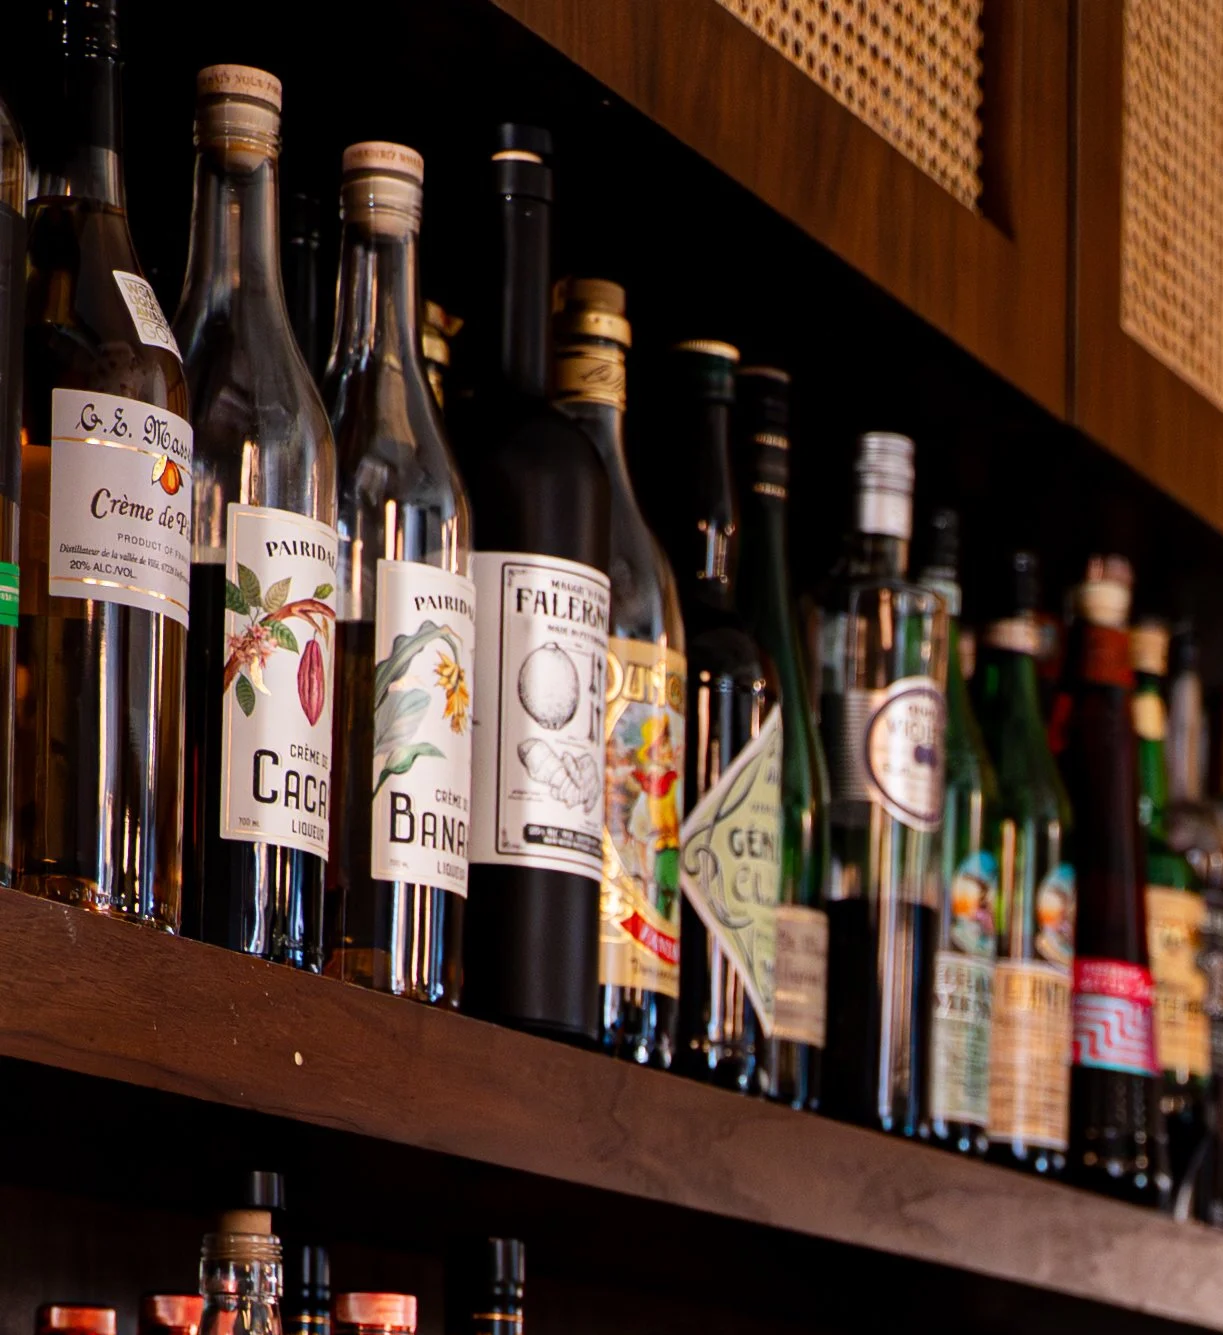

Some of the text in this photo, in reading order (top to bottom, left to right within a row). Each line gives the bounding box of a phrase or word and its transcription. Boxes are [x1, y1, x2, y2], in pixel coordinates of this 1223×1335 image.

[143, 415, 192, 463] Mass
[90, 488, 154, 521] Crème
[158, 505, 174, 529] de
[117, 532, 162, 550] PRODUCT
[164, 545, 174, 556] OF
[265, 540, 336, 572] PAIRIDA
[69, 559, 91, 571] 20%
[414, 595, 474, 622] PAIRIDA
[516, 587, 608, 632] FALERN
[290, 743, 320, 766] CRÈME
[252, 748, 327, 820] CACA
[292, 819, 325, 841] LIQUEUR
[389, 791, 468, 858] BANA
